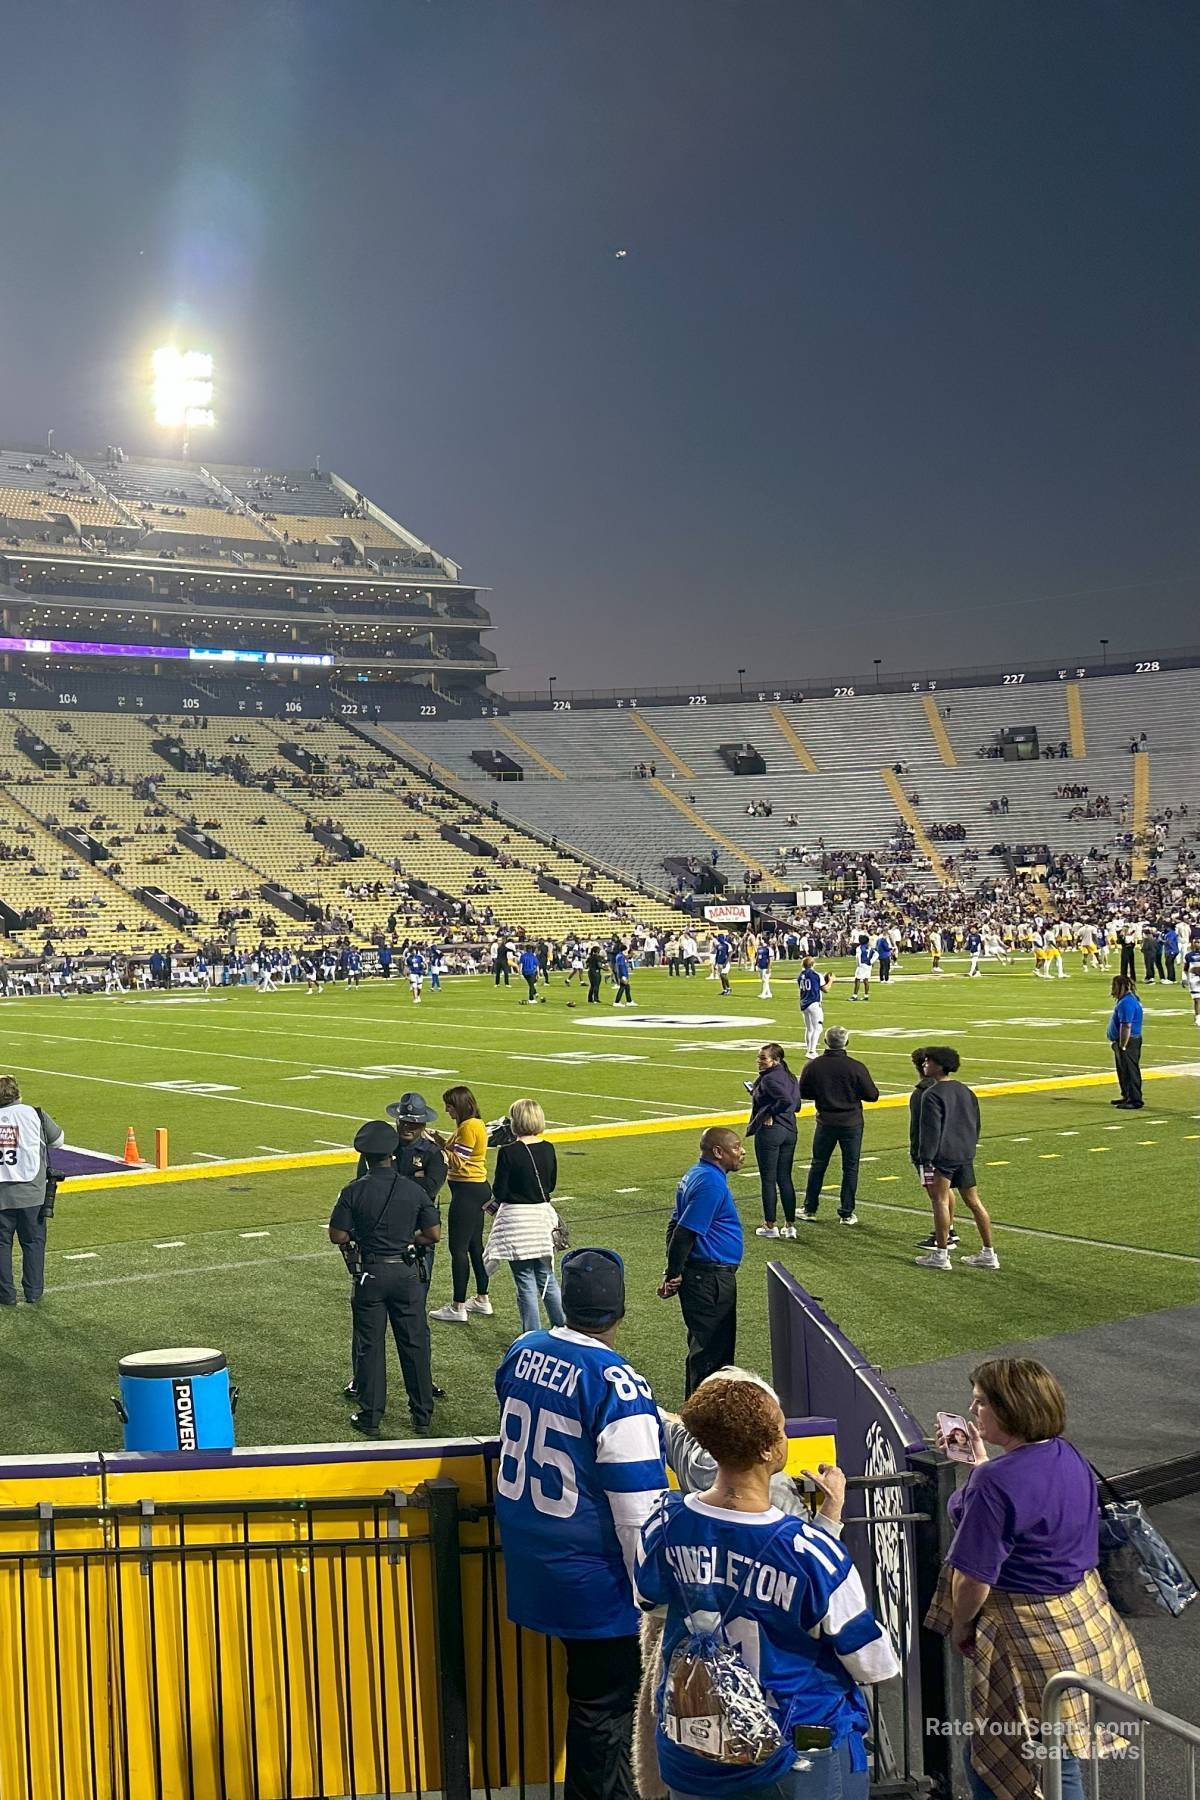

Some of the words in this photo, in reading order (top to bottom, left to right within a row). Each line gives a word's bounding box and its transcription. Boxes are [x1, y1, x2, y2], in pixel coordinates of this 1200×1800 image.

[1135, 661, 1160, 674] 228
[1003, 673, 1026, 685] 227
[834, 687, 855, 697] 226
[58, 694, 77, 704] 104
[182, 698, 200, 708] 105
[689, 696, 708, 706] 225
[285, 702, 302, 712] 106
[341, 704, 358, 714] 222
[420, 706, 436, 715] 223
[553, 701, 571, 711] 224
[708, 906, 746, 918] MANDA
[507, 1051, 651, 1065] 15
[310, 1064, 460, 1080] 10
[514, 1349, 582, 1397] GREEN
[604, 1364, 652, 1401] 85
[176, 1385, 196, 1451] POWER
[497, 1396, 582, 1519] 85
[793, 1523, 845, 1575] 11
[666, 1545, 798, 1612] SINGLETON
